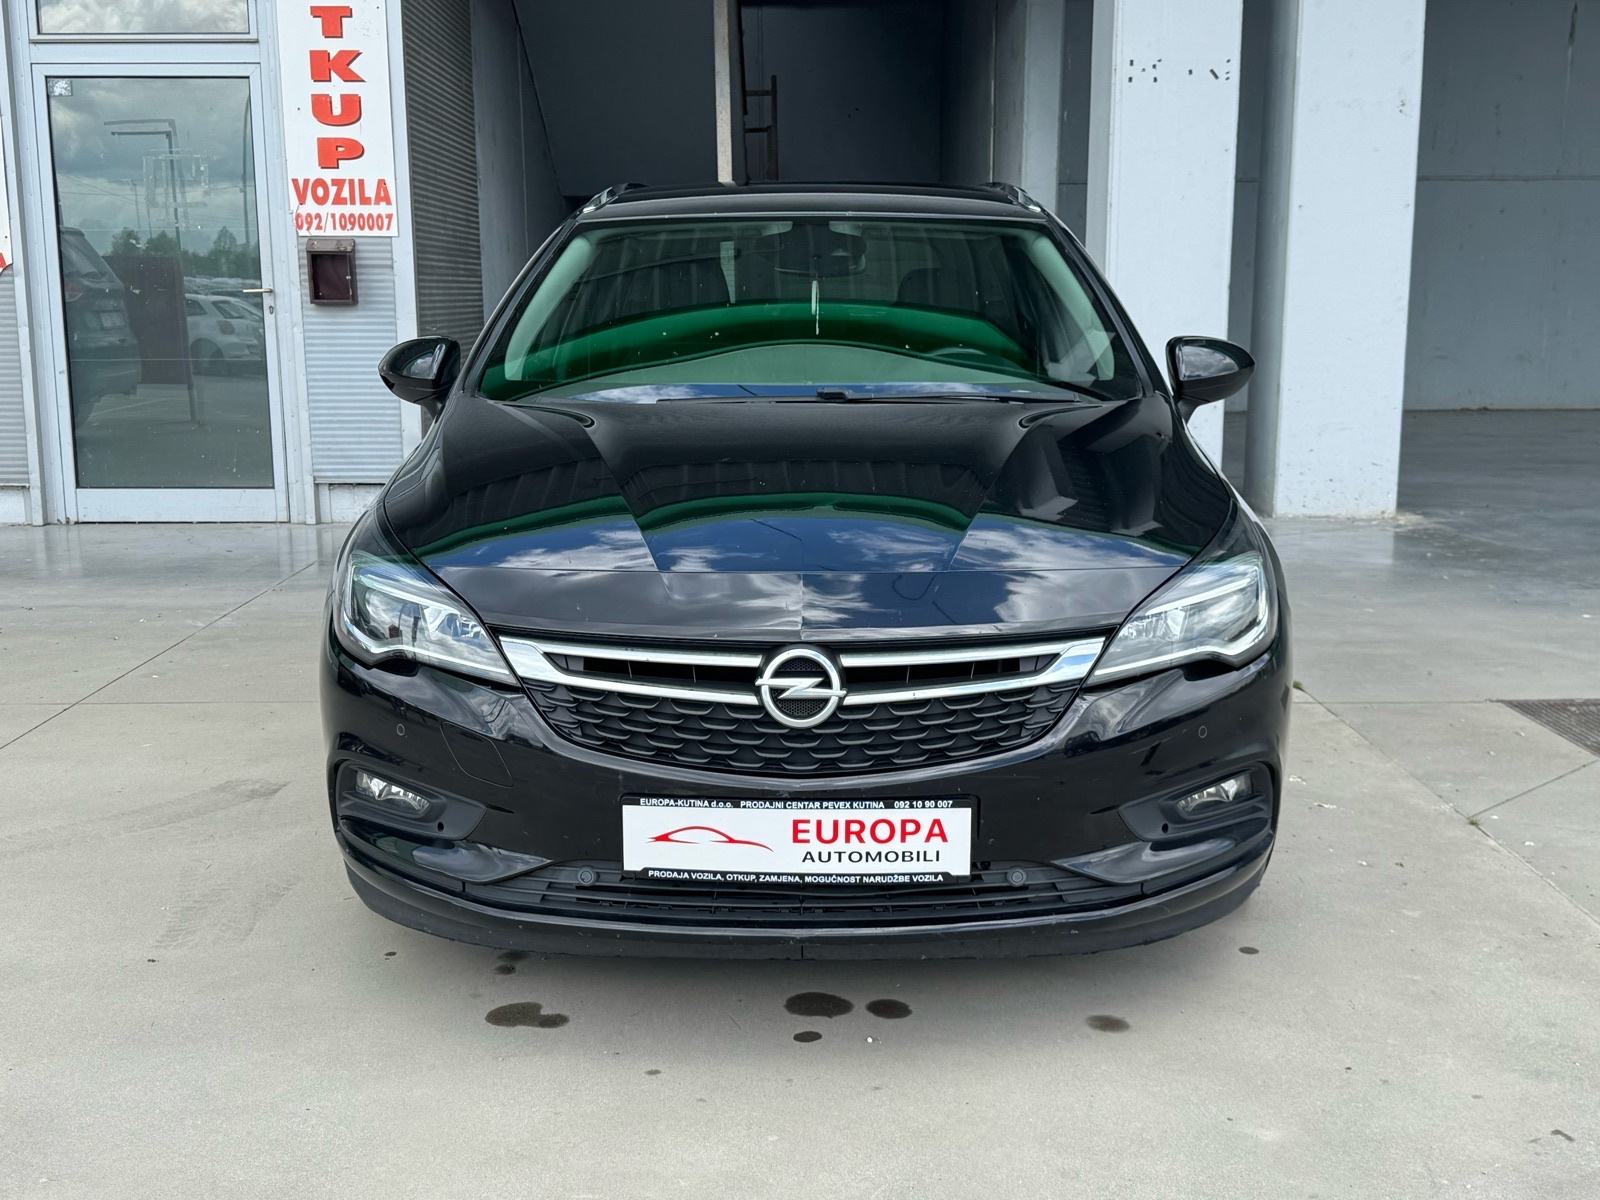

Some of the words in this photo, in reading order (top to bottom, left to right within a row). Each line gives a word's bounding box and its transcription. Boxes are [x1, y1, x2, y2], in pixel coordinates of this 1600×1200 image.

[291, 177, 392, 207] VOZILA
[294, 211, 394, 232] 092/1090007
[640, 798, 708, 808] EUROPA-KUTINA
[711, 800, 734, 808] d.o.o.
[740, 800, 784, 809] PRODAJNI
[786, 801, 820, 809] CENTAR
[823, 801, 850, 809] PEVEX
[853, 801, 885, 809] KUTINA
[894, 801, 910, 809] 092
[925, 800, 935, 808] 90
[938, 800, 953, 808] 007
[792, 818, 948, 844] EUROPA
[802, 850, 940, 863] AUTOMOBILI
[648, 870, 690, 879] PRODAJA
[691, 872, 724, 881] VOZILA,
[726, 873, 757, 882] OTKUP,
[759, 875, 802, 883] ZAMJENA,
[862, 873, 910, 883] NARUDŽBE
[912, 874, 944, 882] VOZILA
